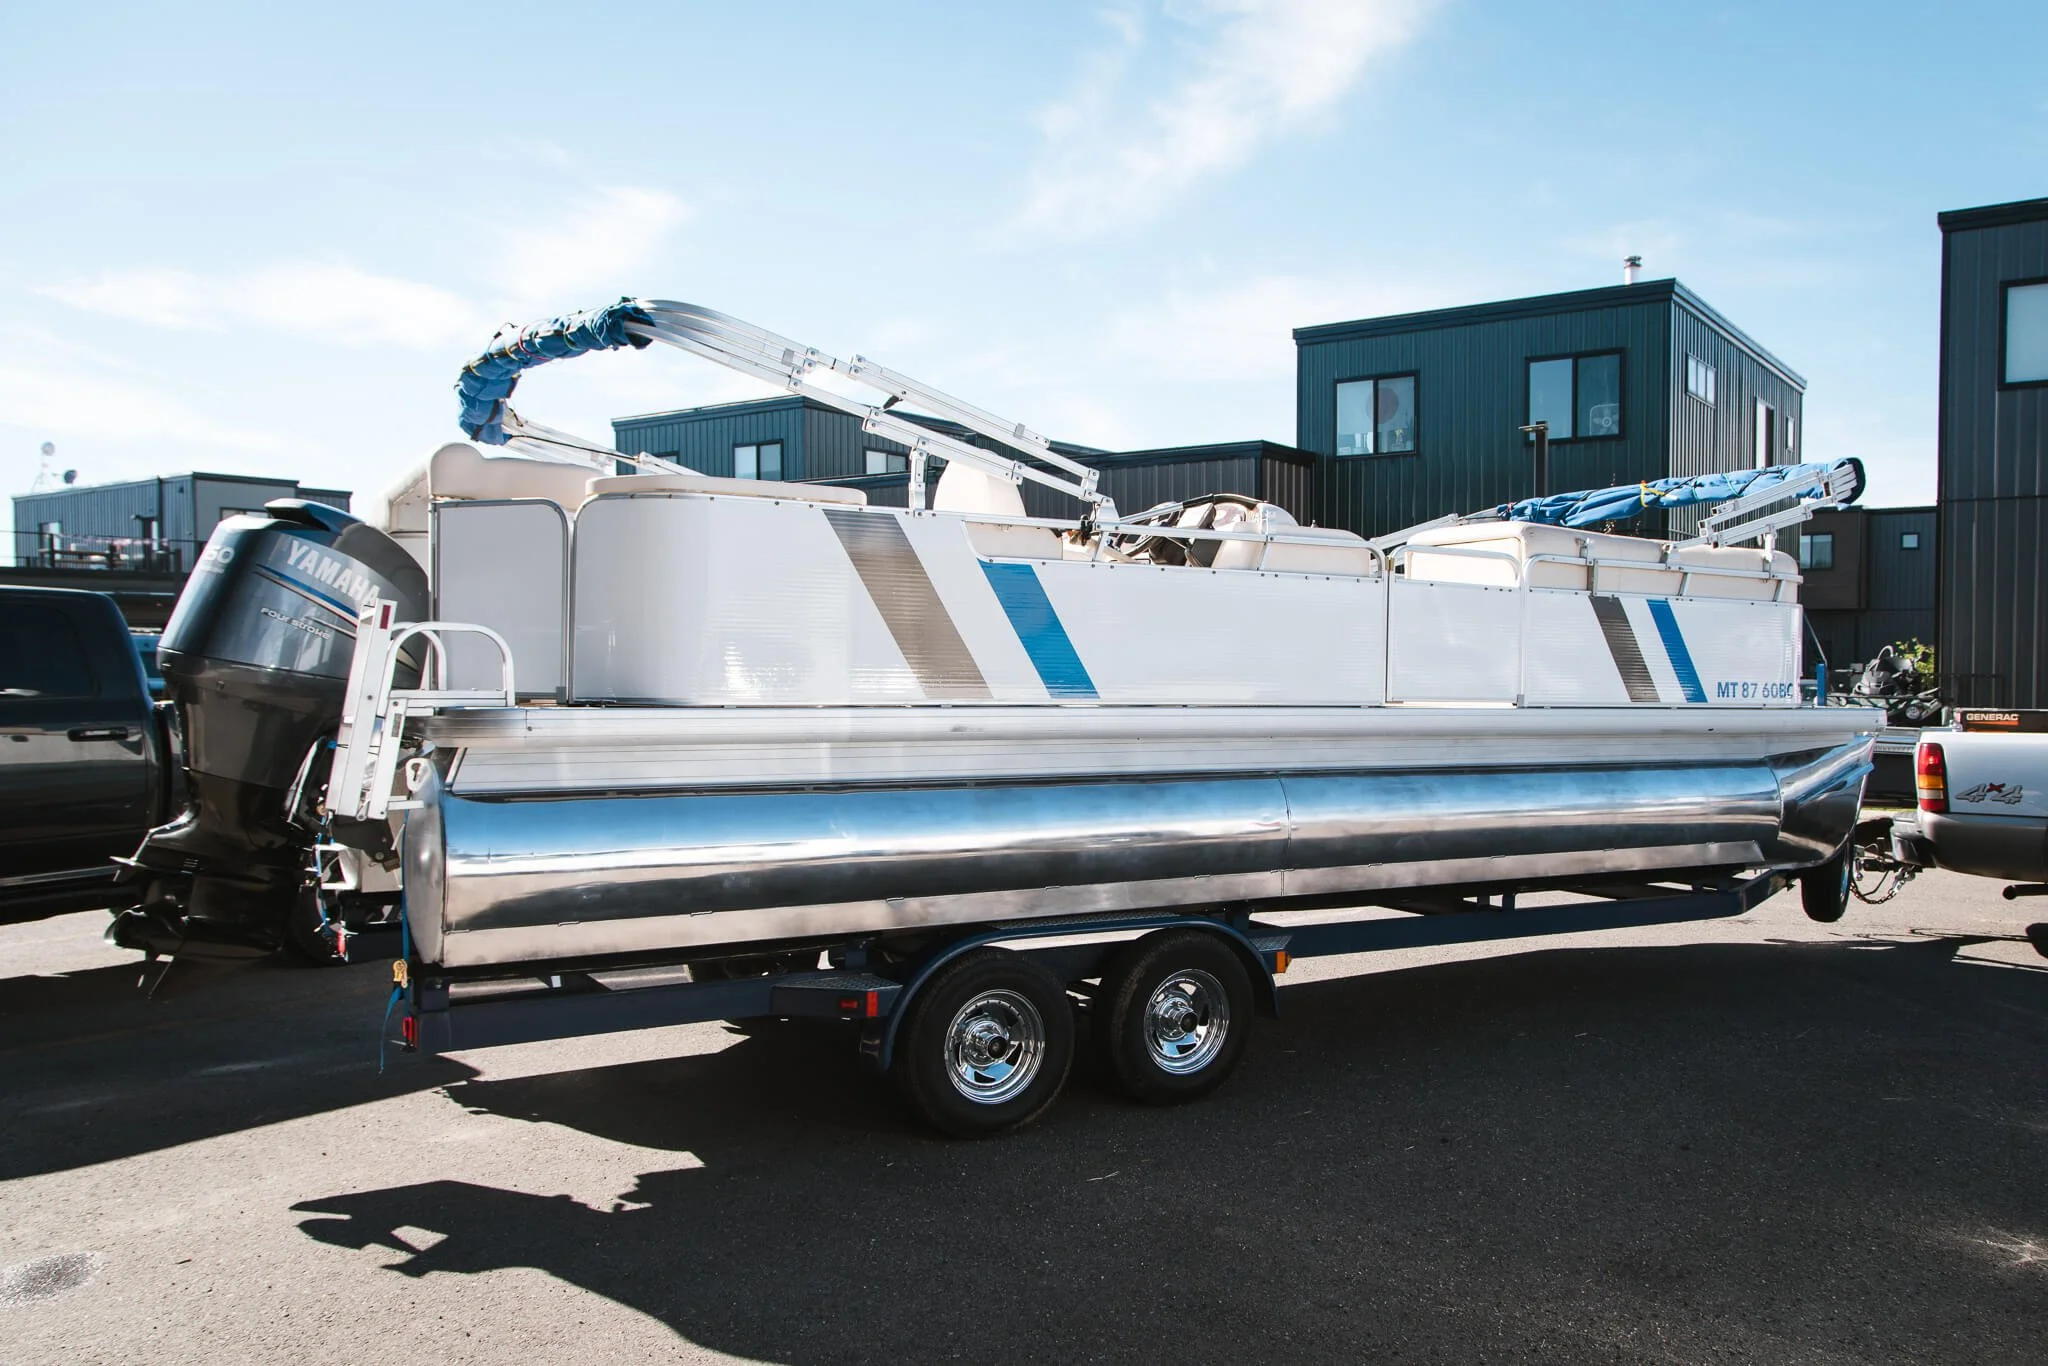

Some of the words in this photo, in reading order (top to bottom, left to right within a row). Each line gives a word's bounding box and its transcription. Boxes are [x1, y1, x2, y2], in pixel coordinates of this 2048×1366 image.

[286, 538, 381, 607] YAMAHA
[260, 607, 290, 623] FOUR
[1717, 682, 1738, 698] MT
[1741, 682, 1758, 699] 87
[1966, 712, 2020, 721] GENERAC
